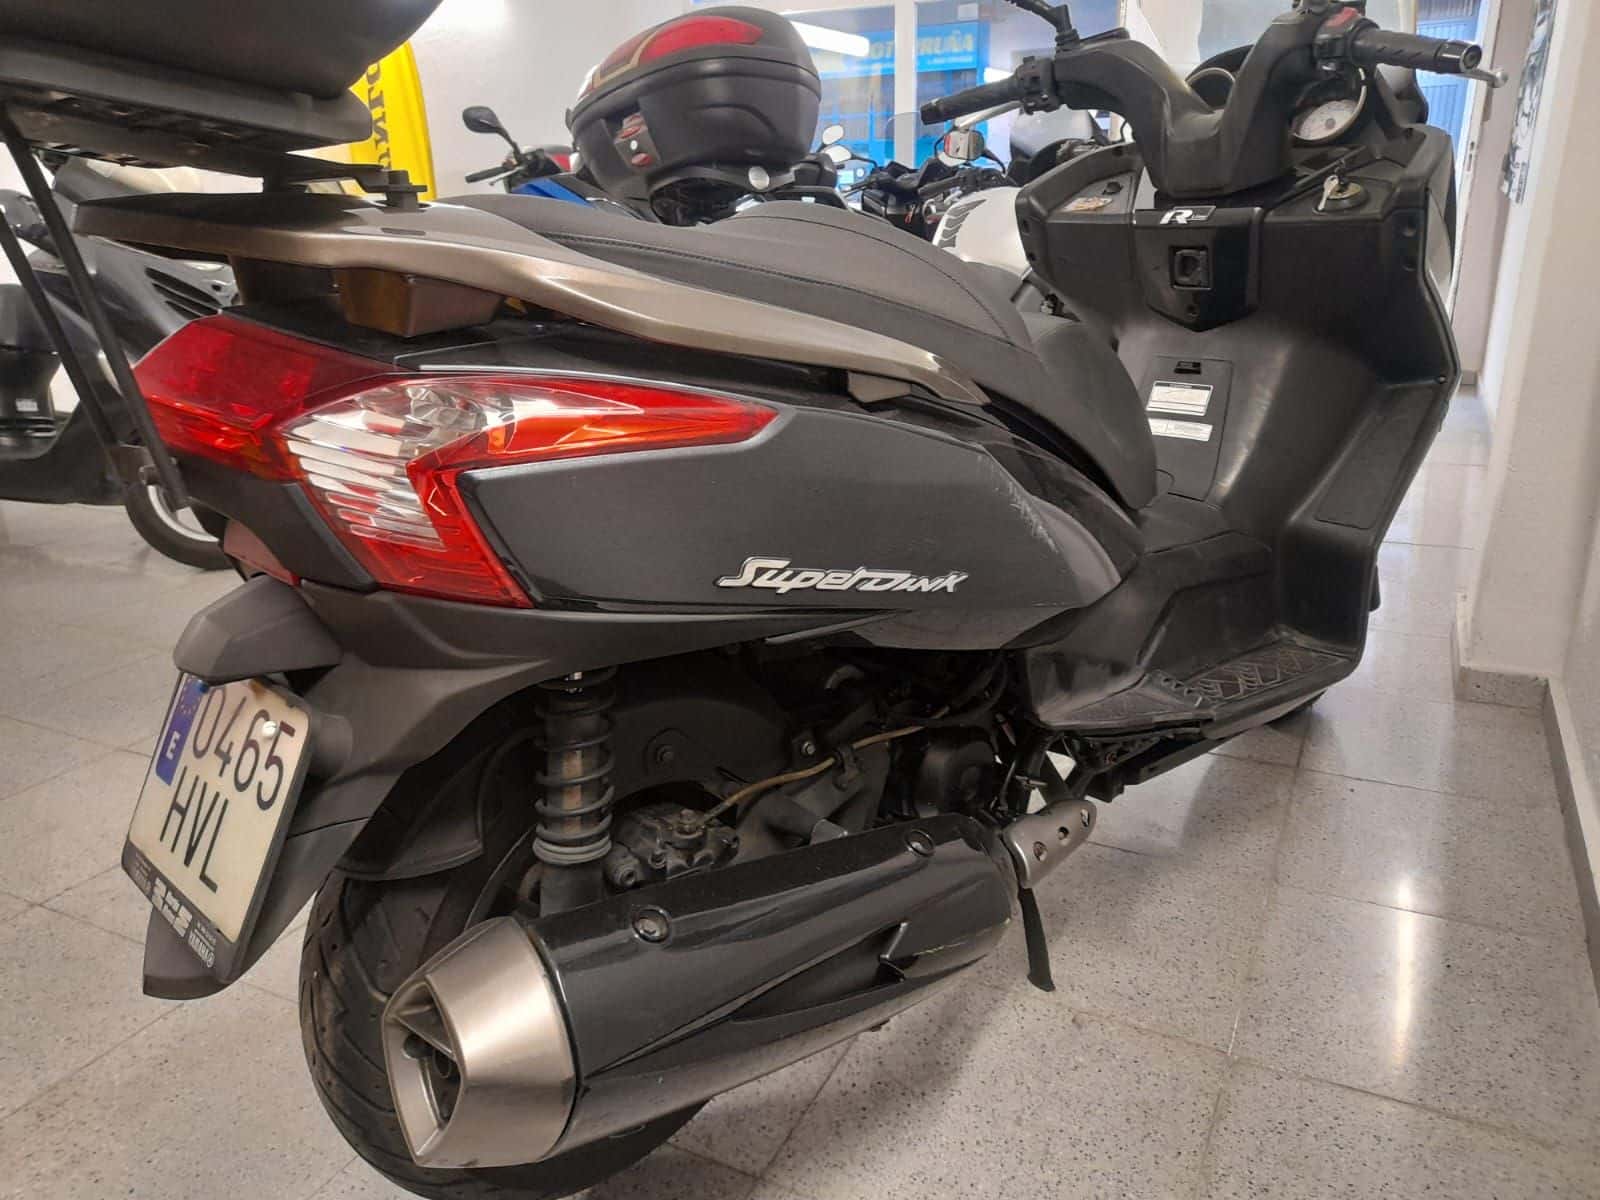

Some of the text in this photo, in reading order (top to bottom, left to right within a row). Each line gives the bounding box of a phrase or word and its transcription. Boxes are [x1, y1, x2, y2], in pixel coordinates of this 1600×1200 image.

[165, 730, 181, 760] E
[192, 686, 296, 811] 0465
[159, 766, 229, 894] HVL
